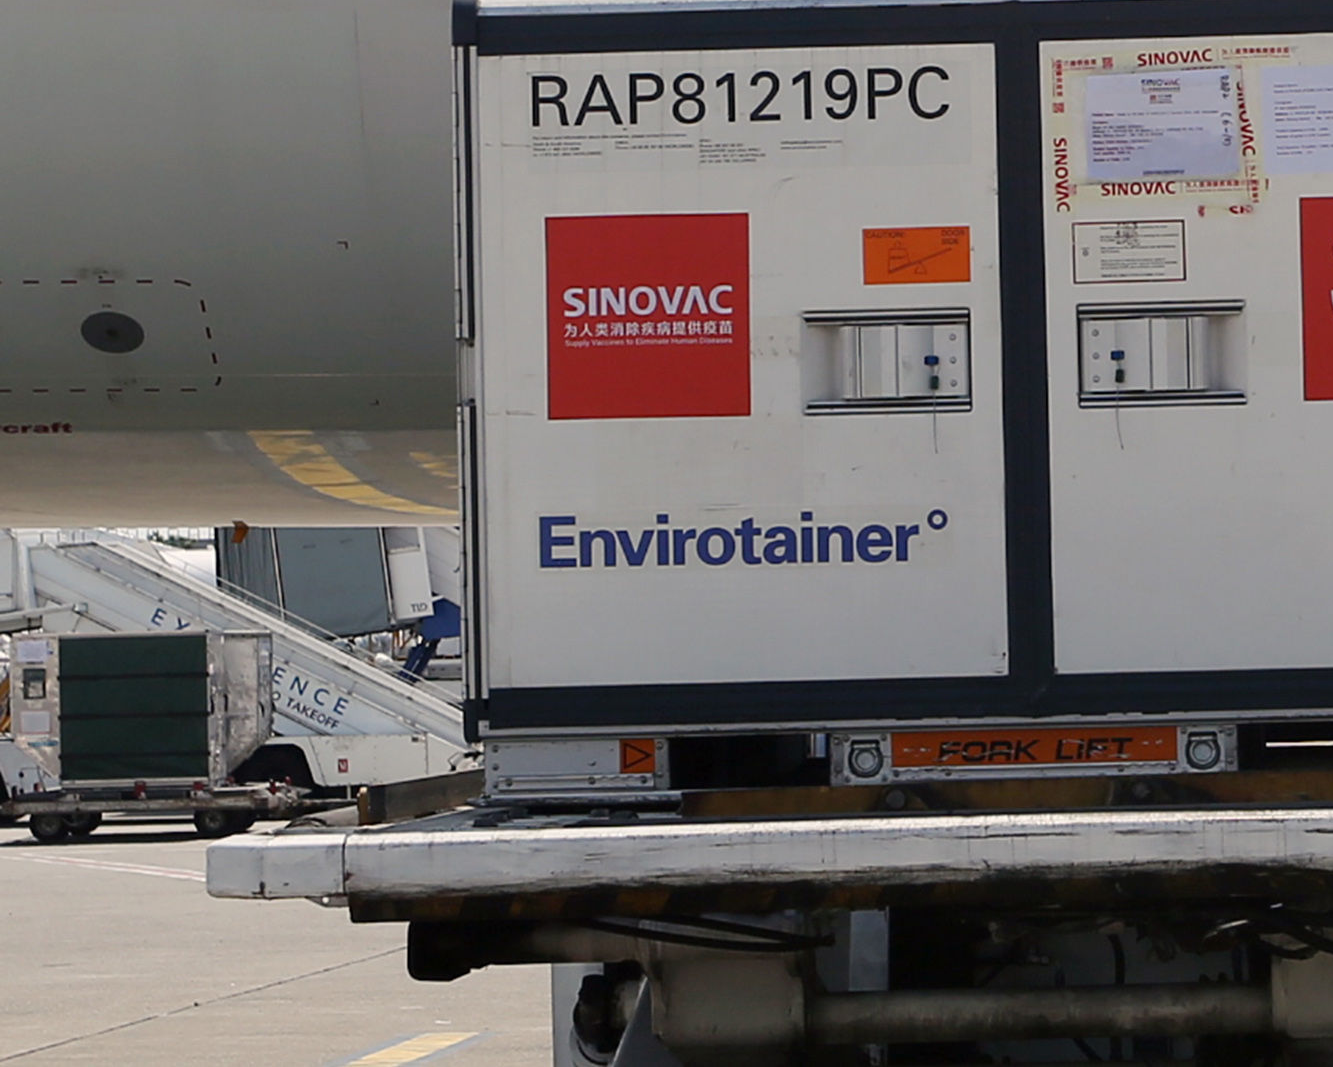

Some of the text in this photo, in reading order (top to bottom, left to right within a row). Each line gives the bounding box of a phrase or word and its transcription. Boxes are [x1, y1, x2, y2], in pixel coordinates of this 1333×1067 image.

[1137, 48, 1213, 67] SINOVAC
[530, 65, 951, 128] RAP81219PC
[1053, 137, 1071, 213] SINOVAC
[1101, 180, 1177, 197] SINOVAC
[563, 285, 733, 318] SINOVAC
[0, 422, 73, 434] craft
[285, 692, 341, 730] TAKEOFF
[937, 737, 1133, 763] FORK LIFT
